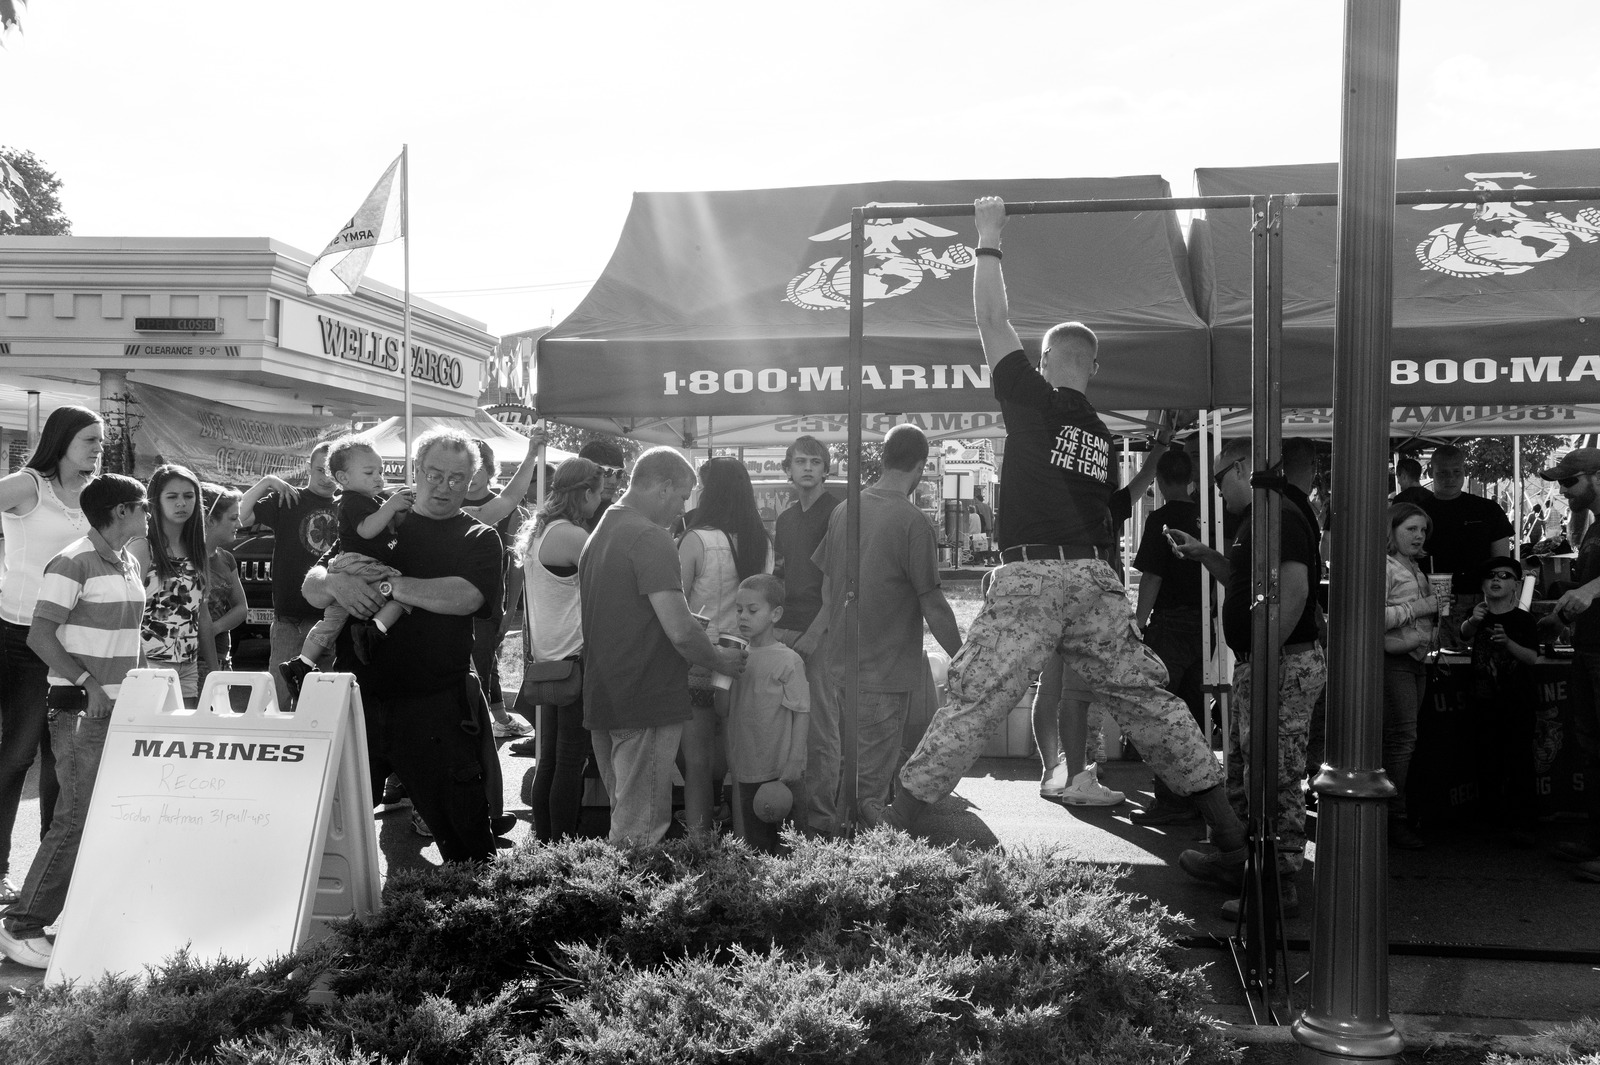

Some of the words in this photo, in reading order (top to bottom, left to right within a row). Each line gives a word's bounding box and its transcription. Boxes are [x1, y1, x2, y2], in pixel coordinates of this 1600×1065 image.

[137, 319, 174, 330] OPEN
[177, 319, 215, 330] CLOSED
[144, 346, 193, 355] CLEARANCE
[318, 314, 400, 372] WELLS
[229, 416, 279, 447] LIBERTY
[1060, 425, 1081, 442] THE
[1055, 436, 1079, 455] THE
[1080, 444, 1108, 470] TEAM!
[383, 463, 405, 474] AVY
[1050, 449, 1075, 470] THE
[1077, 458, 1108, 483] TEAM!
[131, 739, 305, 763] MARINES
[111, 803, 151, 823] Jordan
[158, 803, 203, 825] Hartman
[210, 809, 223, 824] 31
